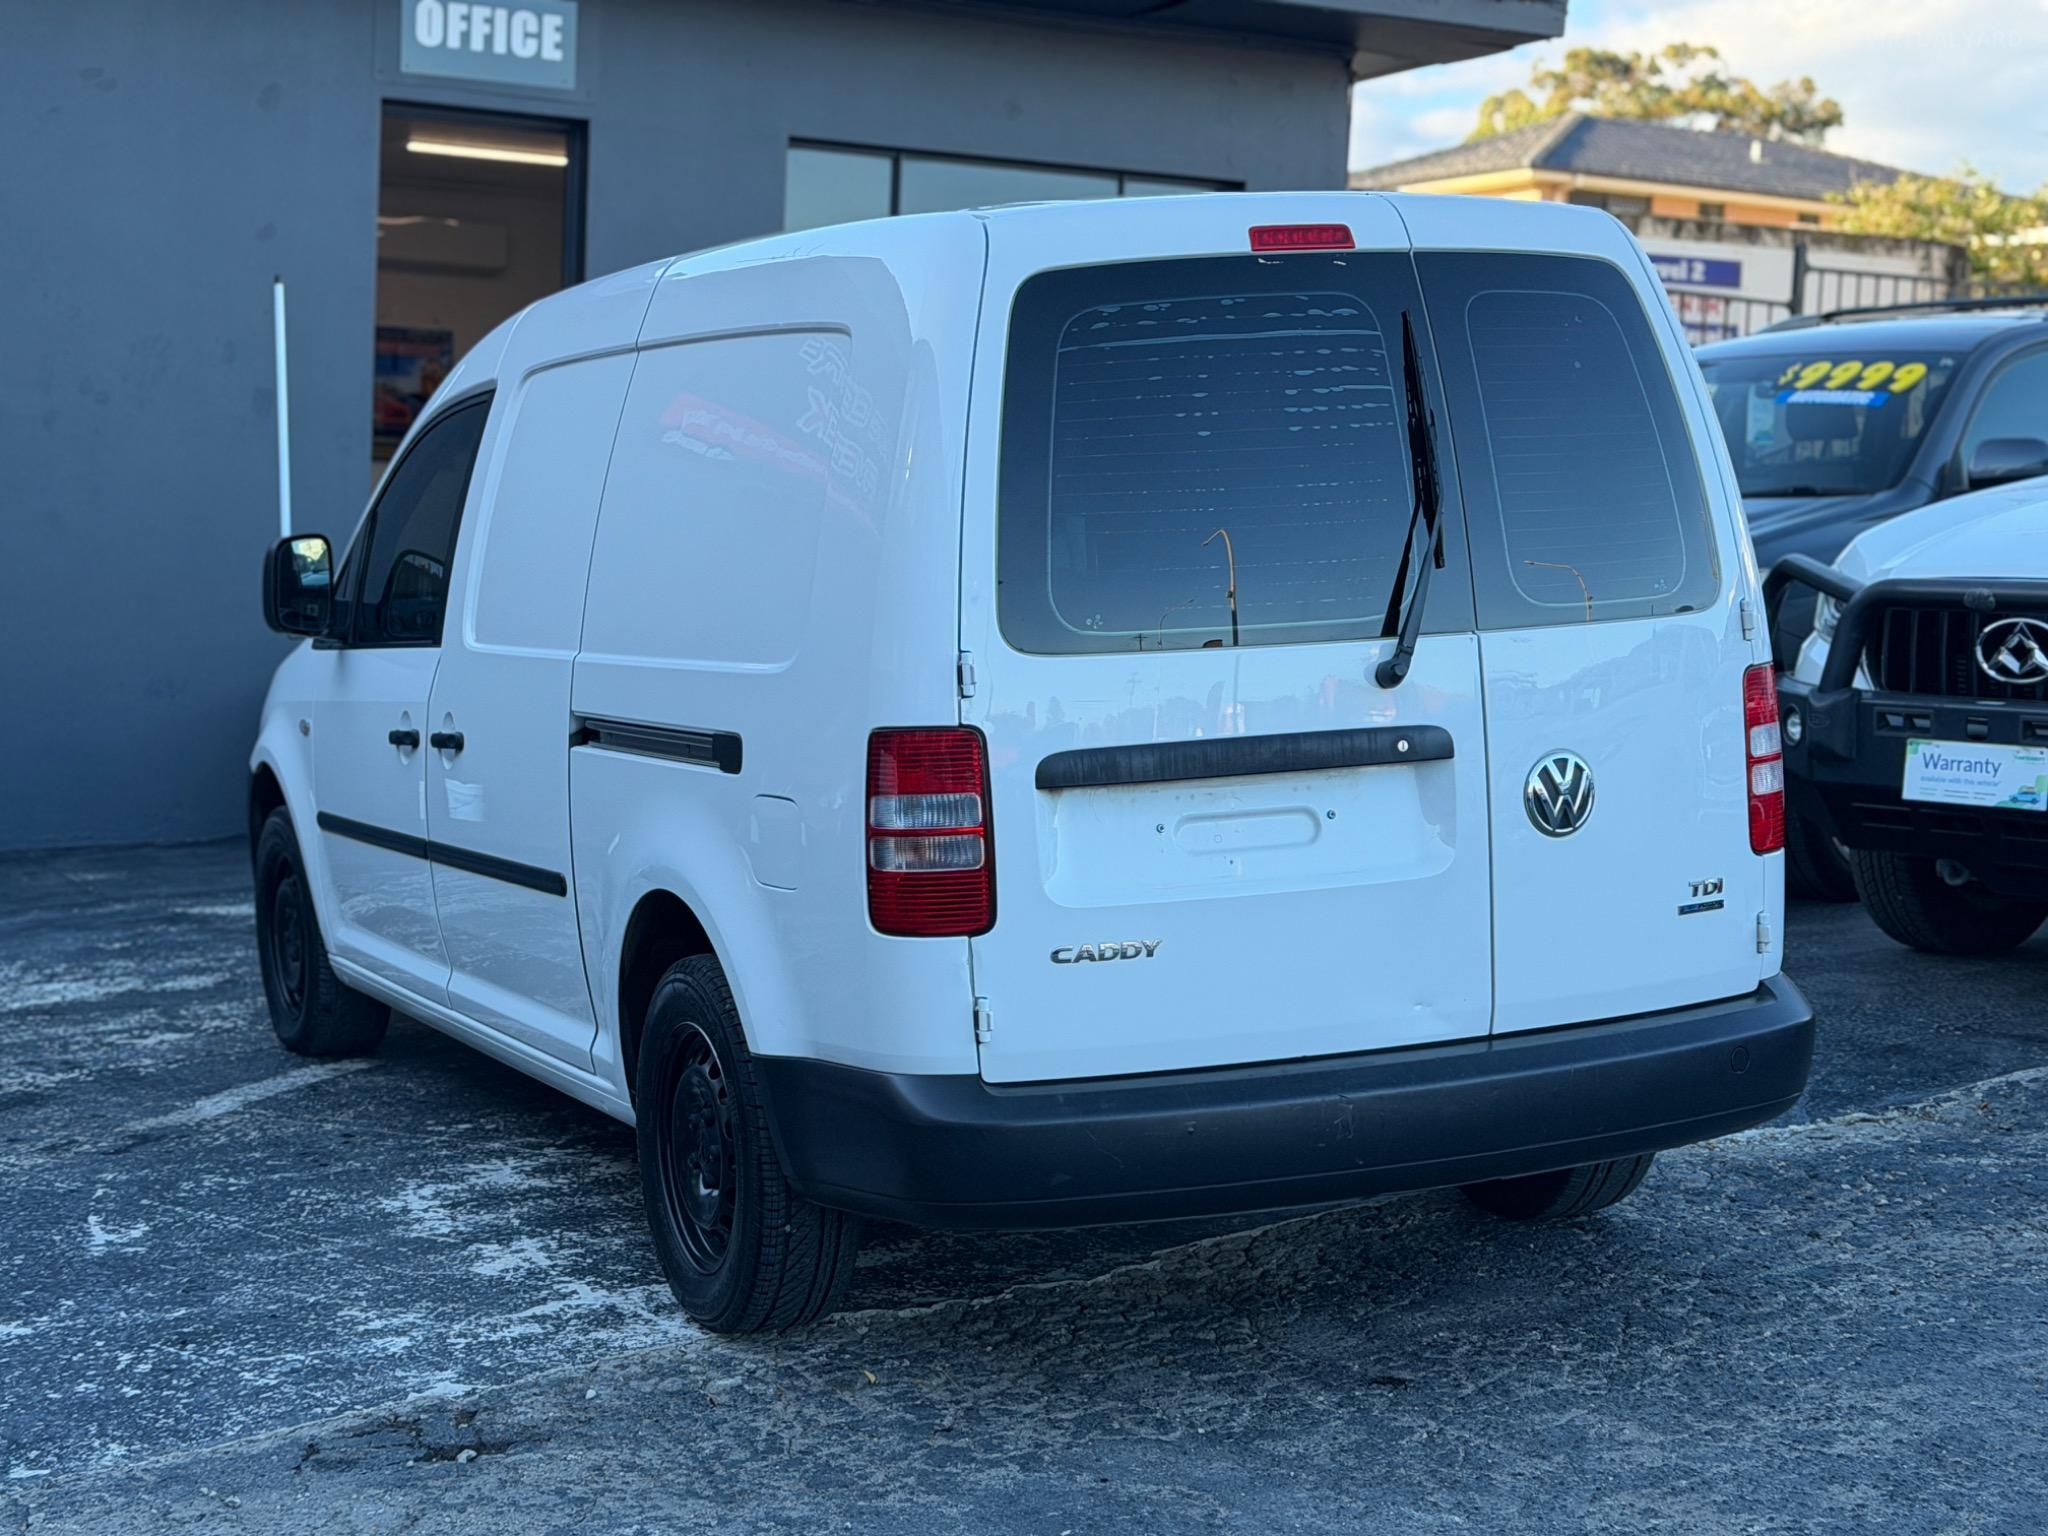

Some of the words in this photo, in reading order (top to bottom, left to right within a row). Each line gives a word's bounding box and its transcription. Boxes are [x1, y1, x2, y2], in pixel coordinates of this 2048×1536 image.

[414, 0, 565, 62] OFFICE
[1777, 360, 1928, 393] $9999
[1922, 752, 2002, 778] Warranty
[1688, 877, 1724, 897] TDI
[1050, 939, 1162, 965] CADDY
